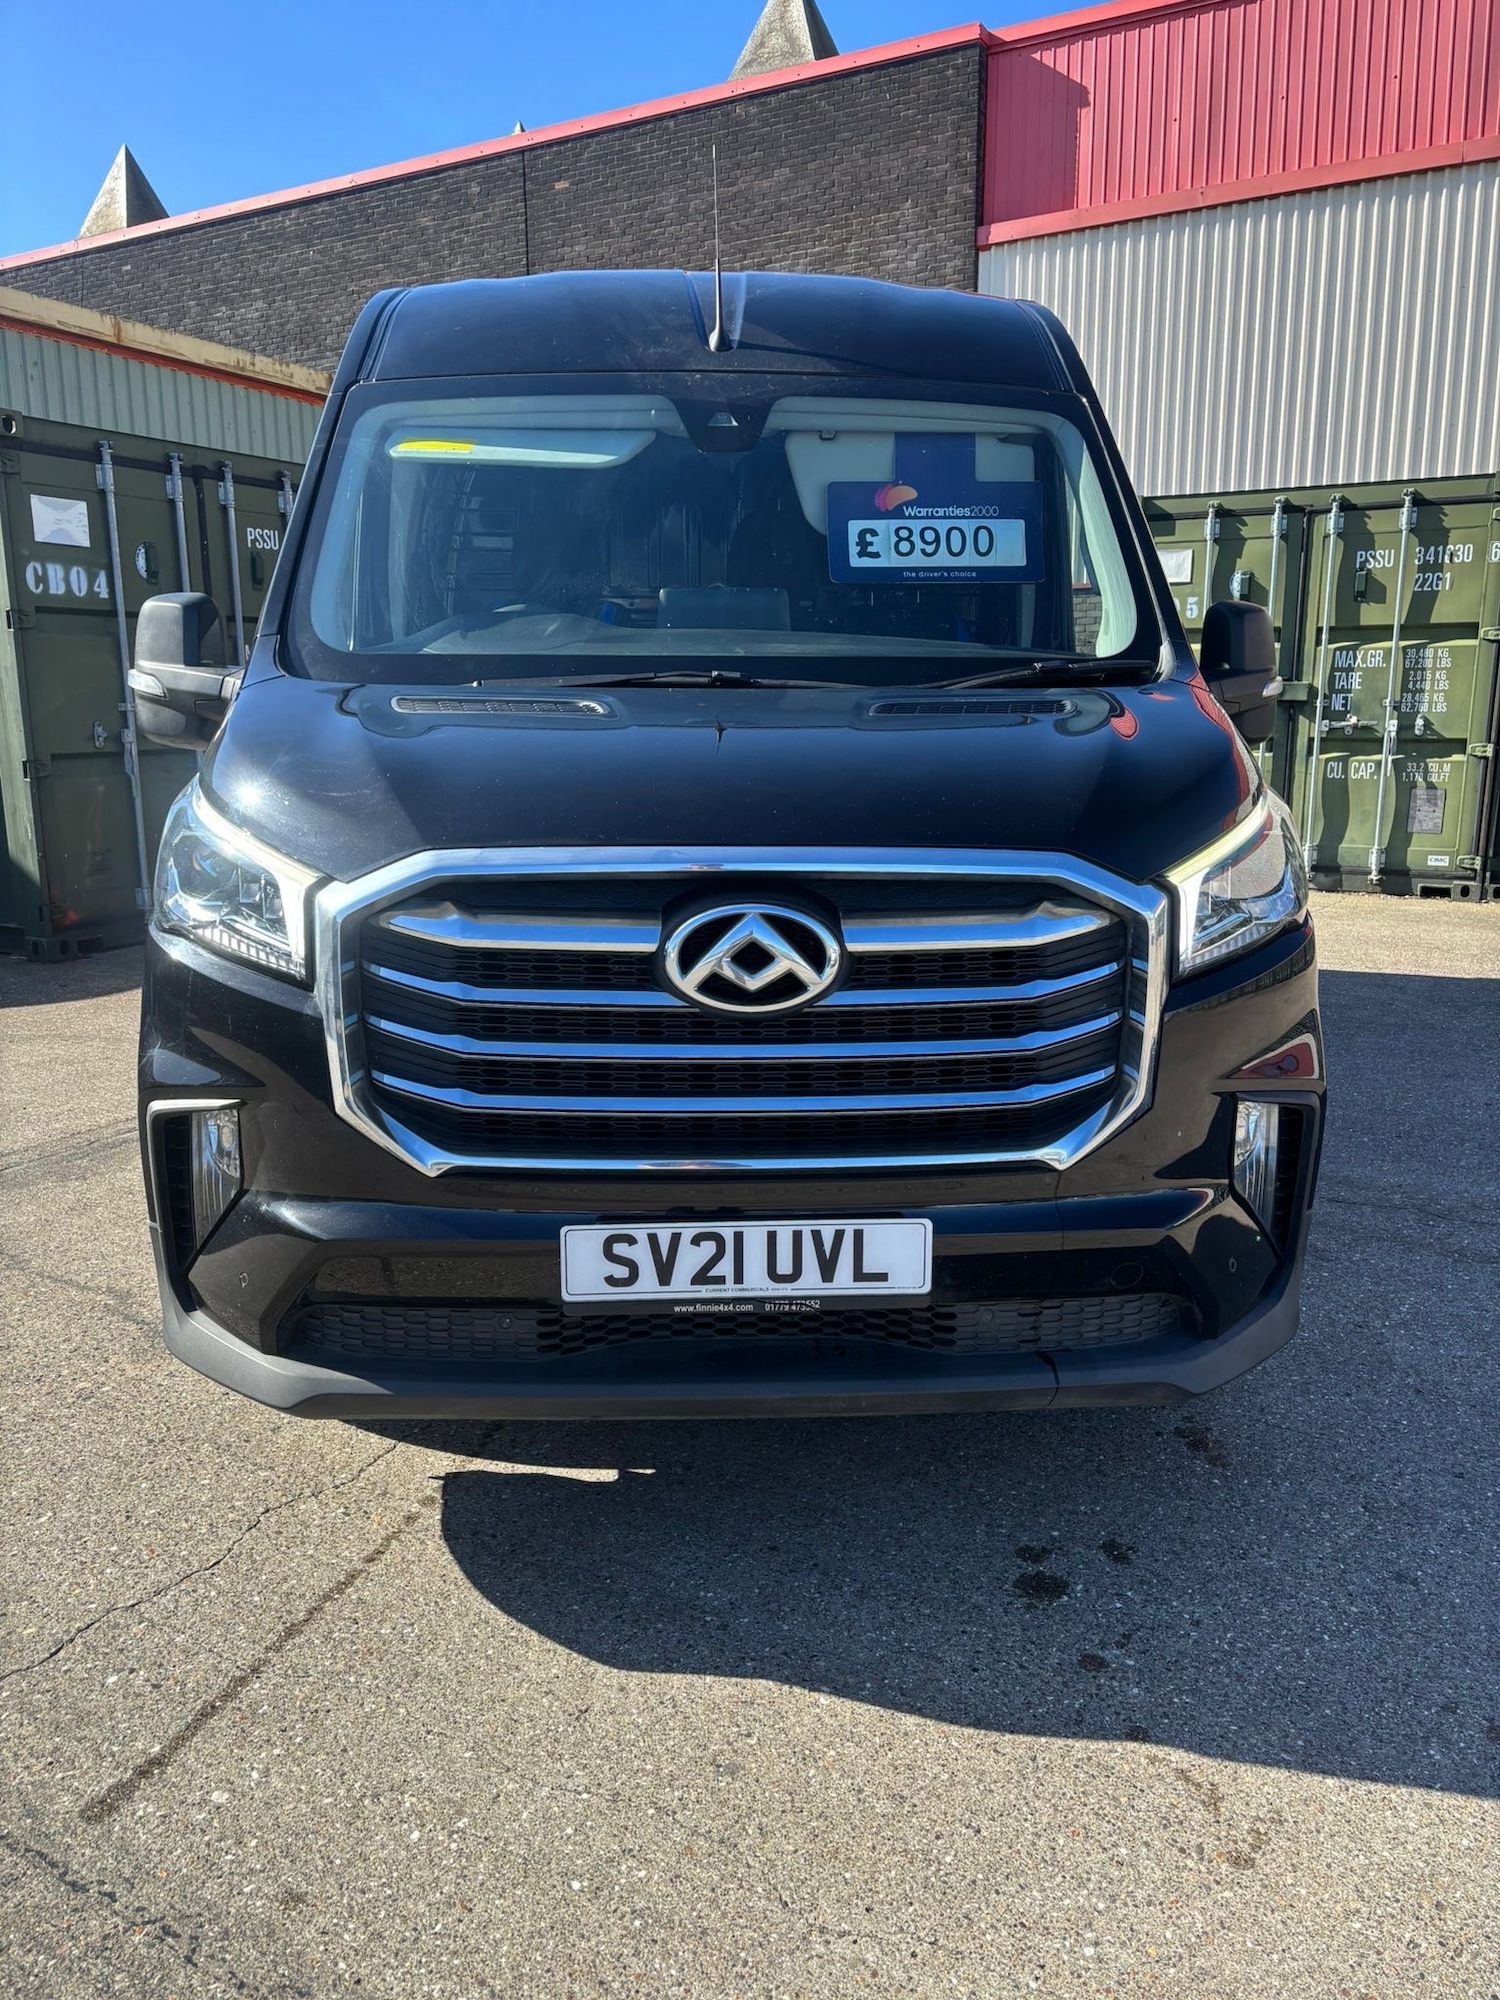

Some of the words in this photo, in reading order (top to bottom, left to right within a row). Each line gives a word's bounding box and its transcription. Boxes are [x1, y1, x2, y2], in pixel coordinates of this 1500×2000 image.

[902, 505, 999, 518] Warranties2000
[246, 527, 279, 550] PSSU
[1356, 549, 1395, 569] PSSU
[903, 570, 916, 578] the
[918, 570, 948, 578] driver's
[950, 570, 977, 578] choice
[1414, 571, 1451, 592] 22G1
[1437, 648, 1449, 658] KG
[1436, 658, 1452, 668] LBS
[1435, 670, 1447, 680] KG
[1333, 672, 1362, 690] TARE
[1434, 680, 1450, 690] LBS
[1330, 693, 1354, 711] NET
[1433, 692, 1445, 702] KG
[1432, 702, 1447, 712] LBS
[1326, 761, 1345, 779] CU.
[1350, 761, 1377, 780] CAP.
[1406, 762, 1425, 773] 33.2
[602, 1230, 745, 1288] SV21
[766, 1228, 889, 1284] UVL
[673, 1303, 754, 1312] www.finnie4x4.com
